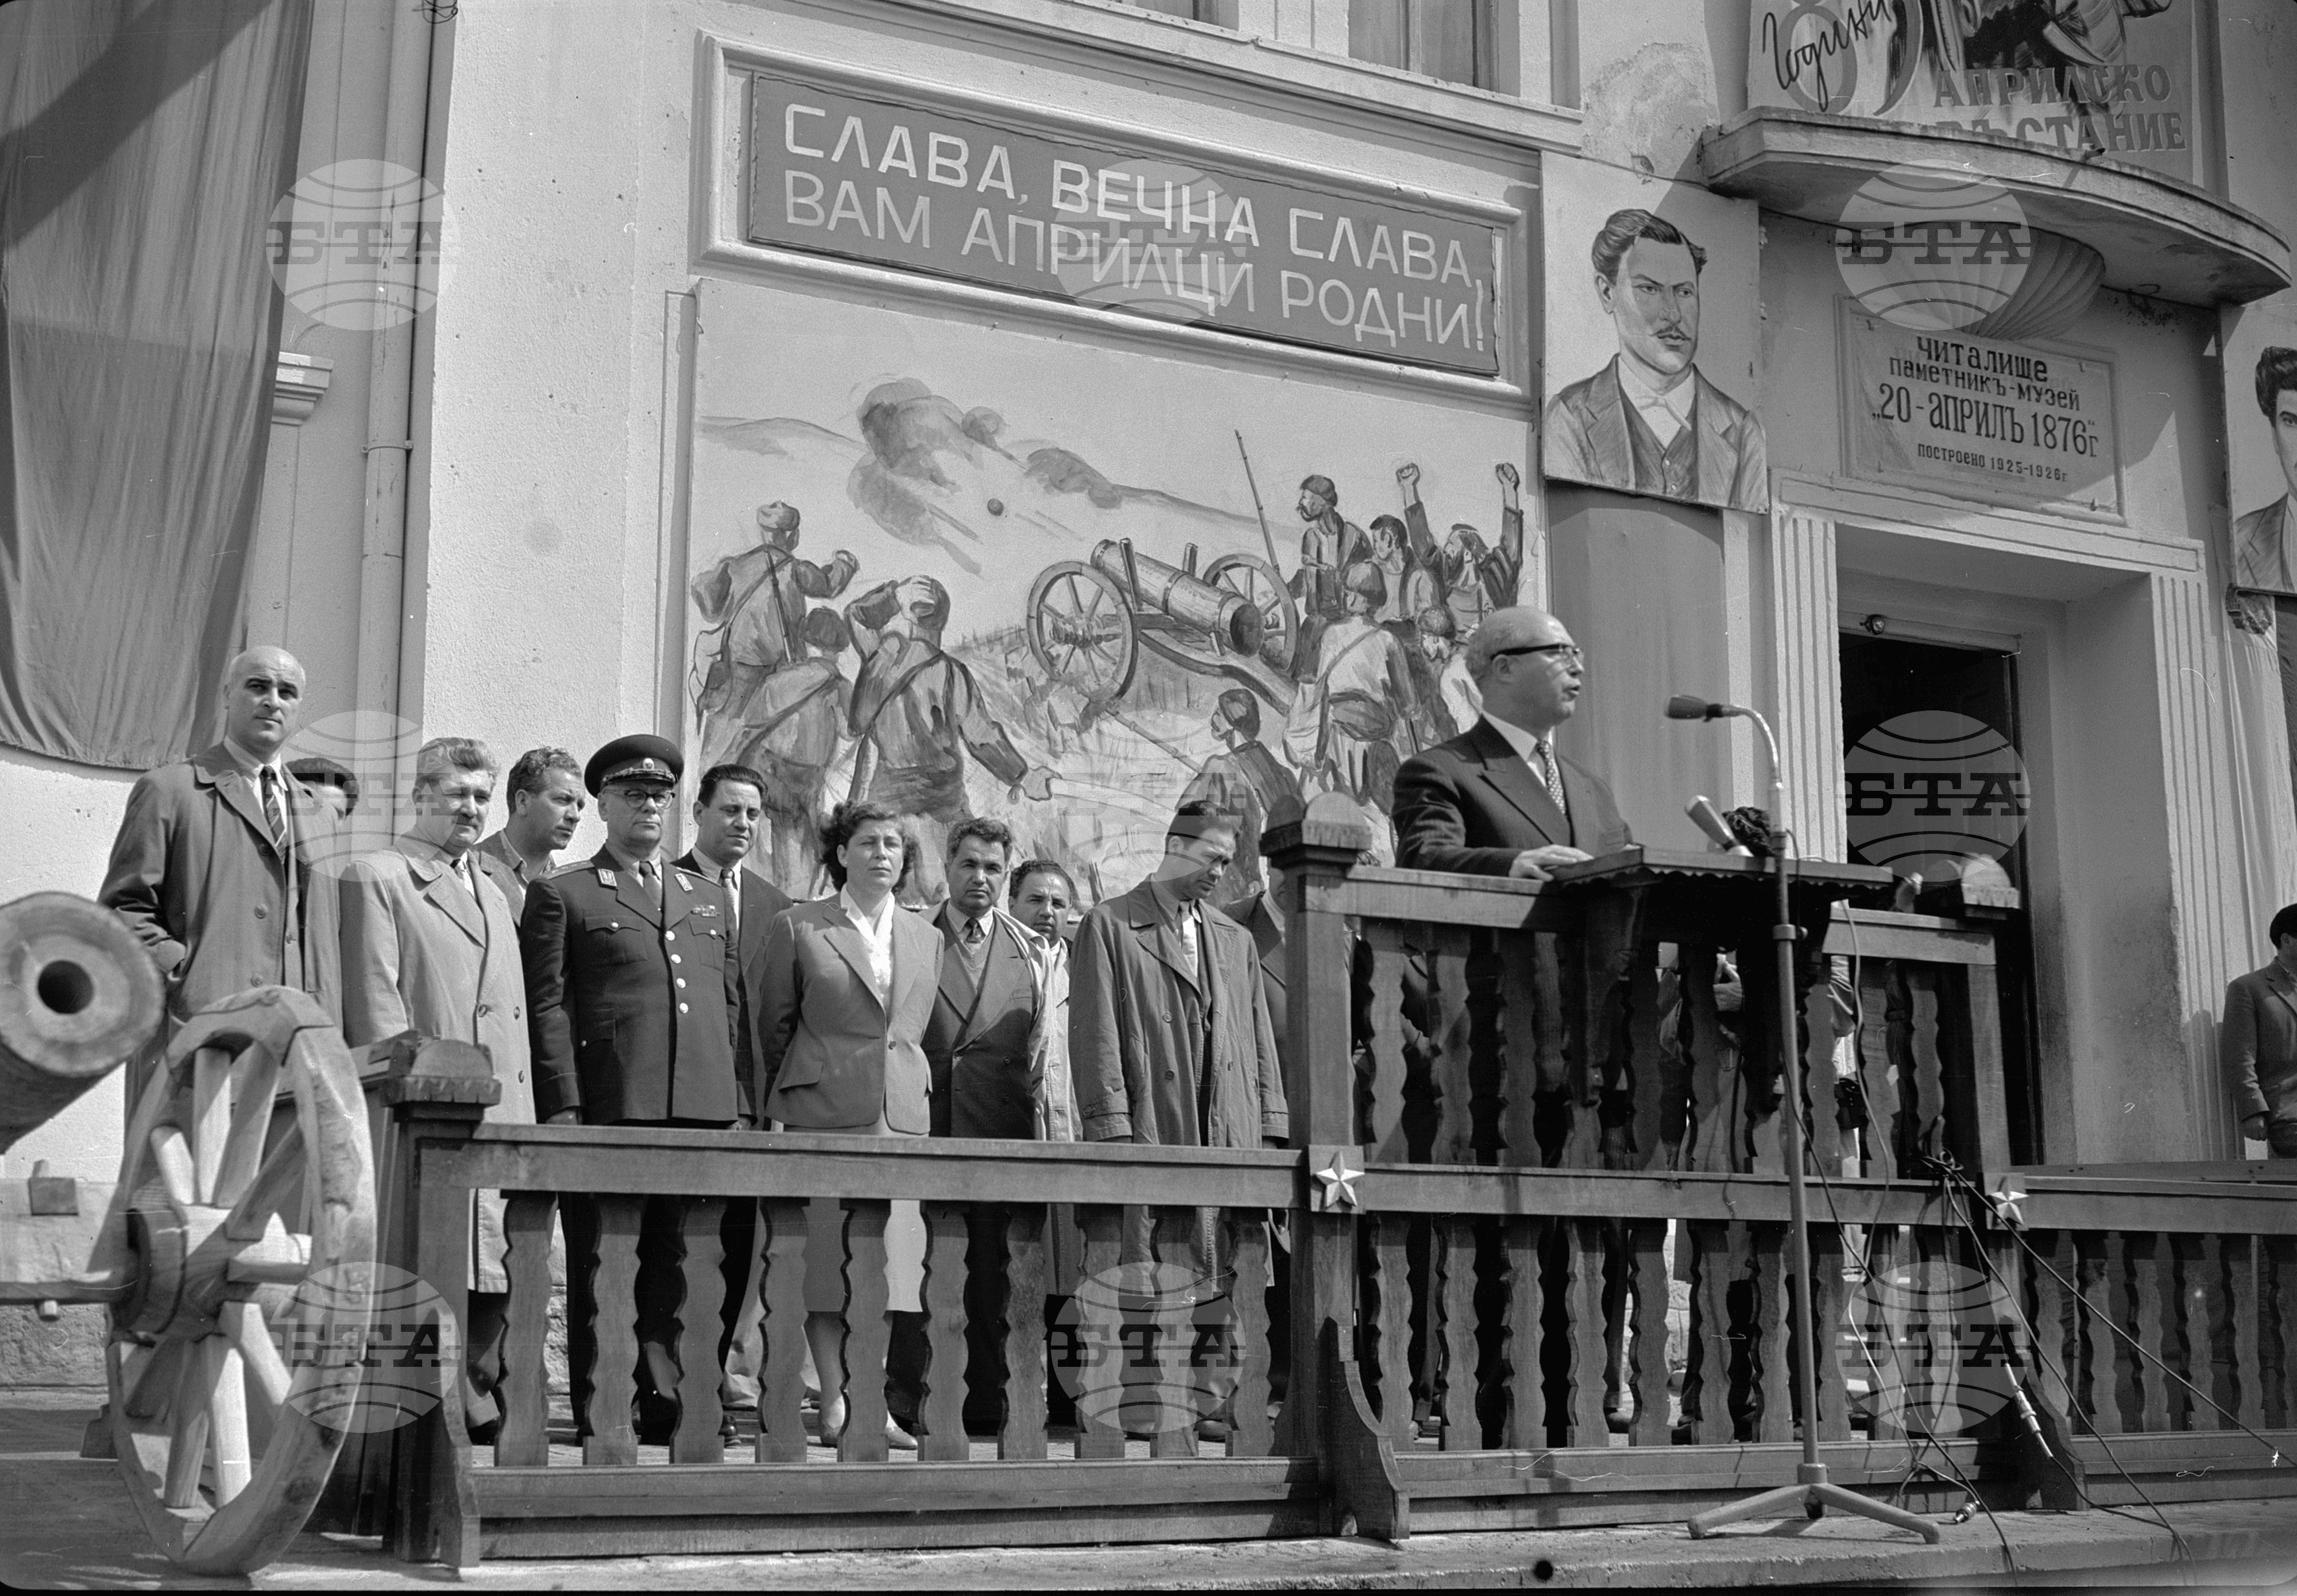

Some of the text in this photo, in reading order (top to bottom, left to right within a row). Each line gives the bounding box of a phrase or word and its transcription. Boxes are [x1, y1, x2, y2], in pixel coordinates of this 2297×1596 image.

[1934, 64, 2171, 107] АПРИЛСКО
[1936, 113, 2186, 151] СТАНИЕ
[785, 103, 1472, 287] СЛАВА, ВЕЧНА СЛАВА
[785, 169, 1484, 351] ВАМ АПРИЛЦИ РОДНИ!
